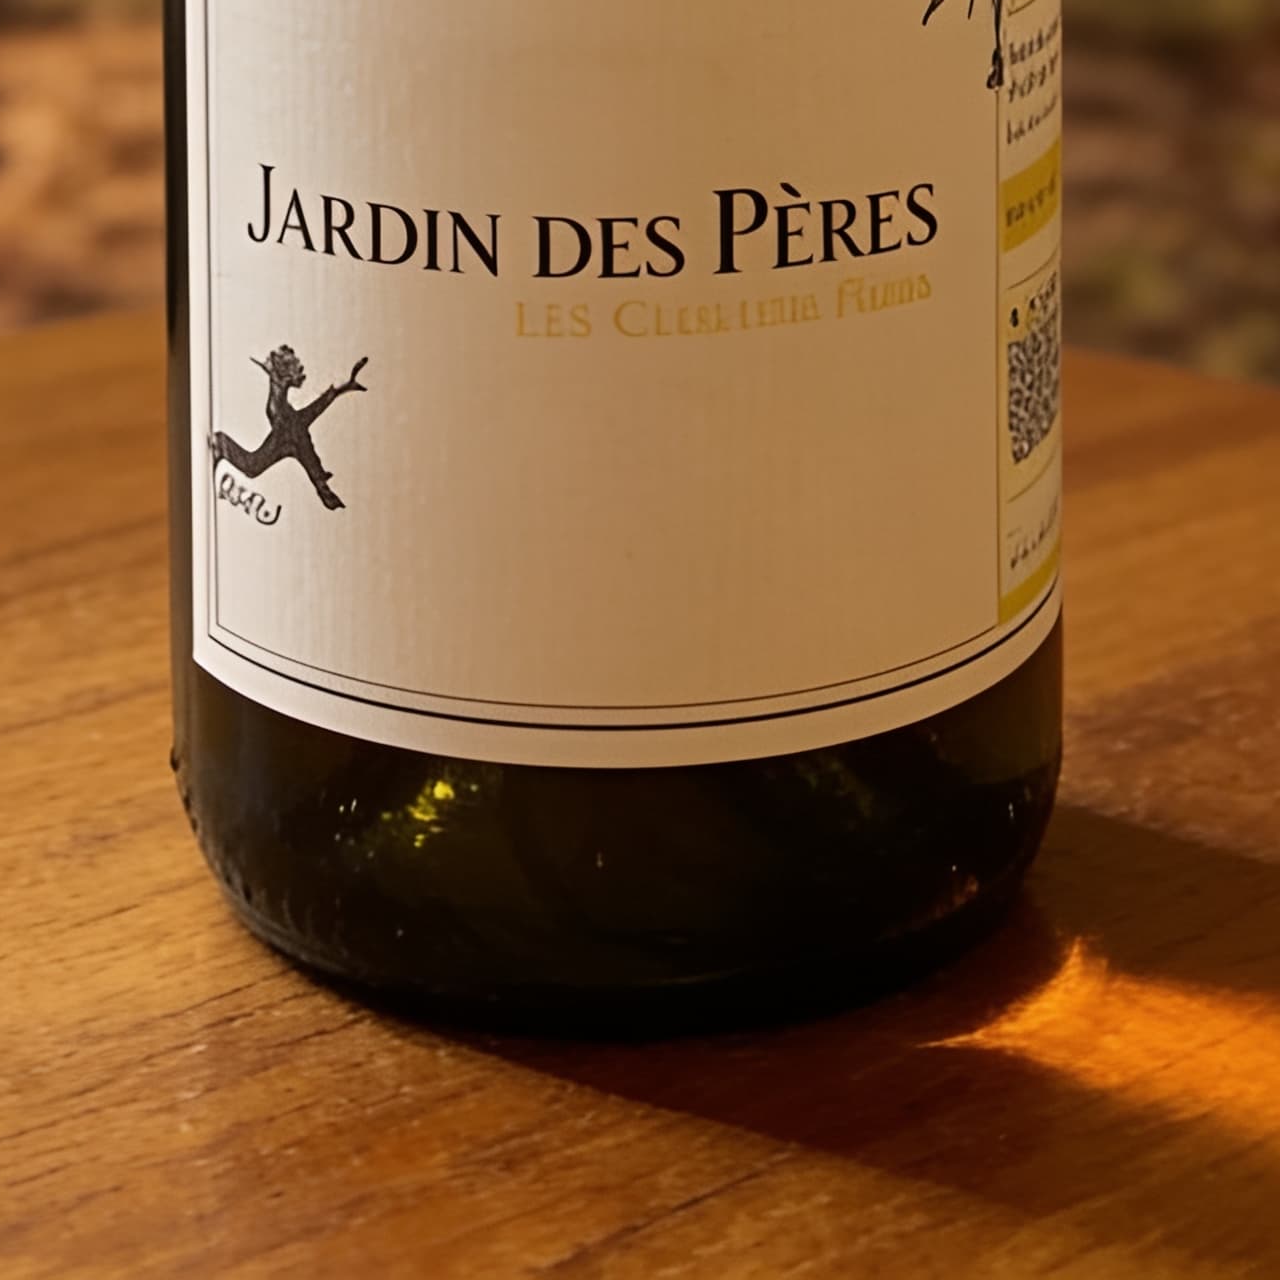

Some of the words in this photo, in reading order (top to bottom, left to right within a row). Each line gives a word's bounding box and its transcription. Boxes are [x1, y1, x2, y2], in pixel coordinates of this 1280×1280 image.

[247, 163, 502, 278] JARDIN
[531, 214, 686, 279] DES
[711, 182, 939, 275] PÈRES
[515, 301, 592, 338] LES
